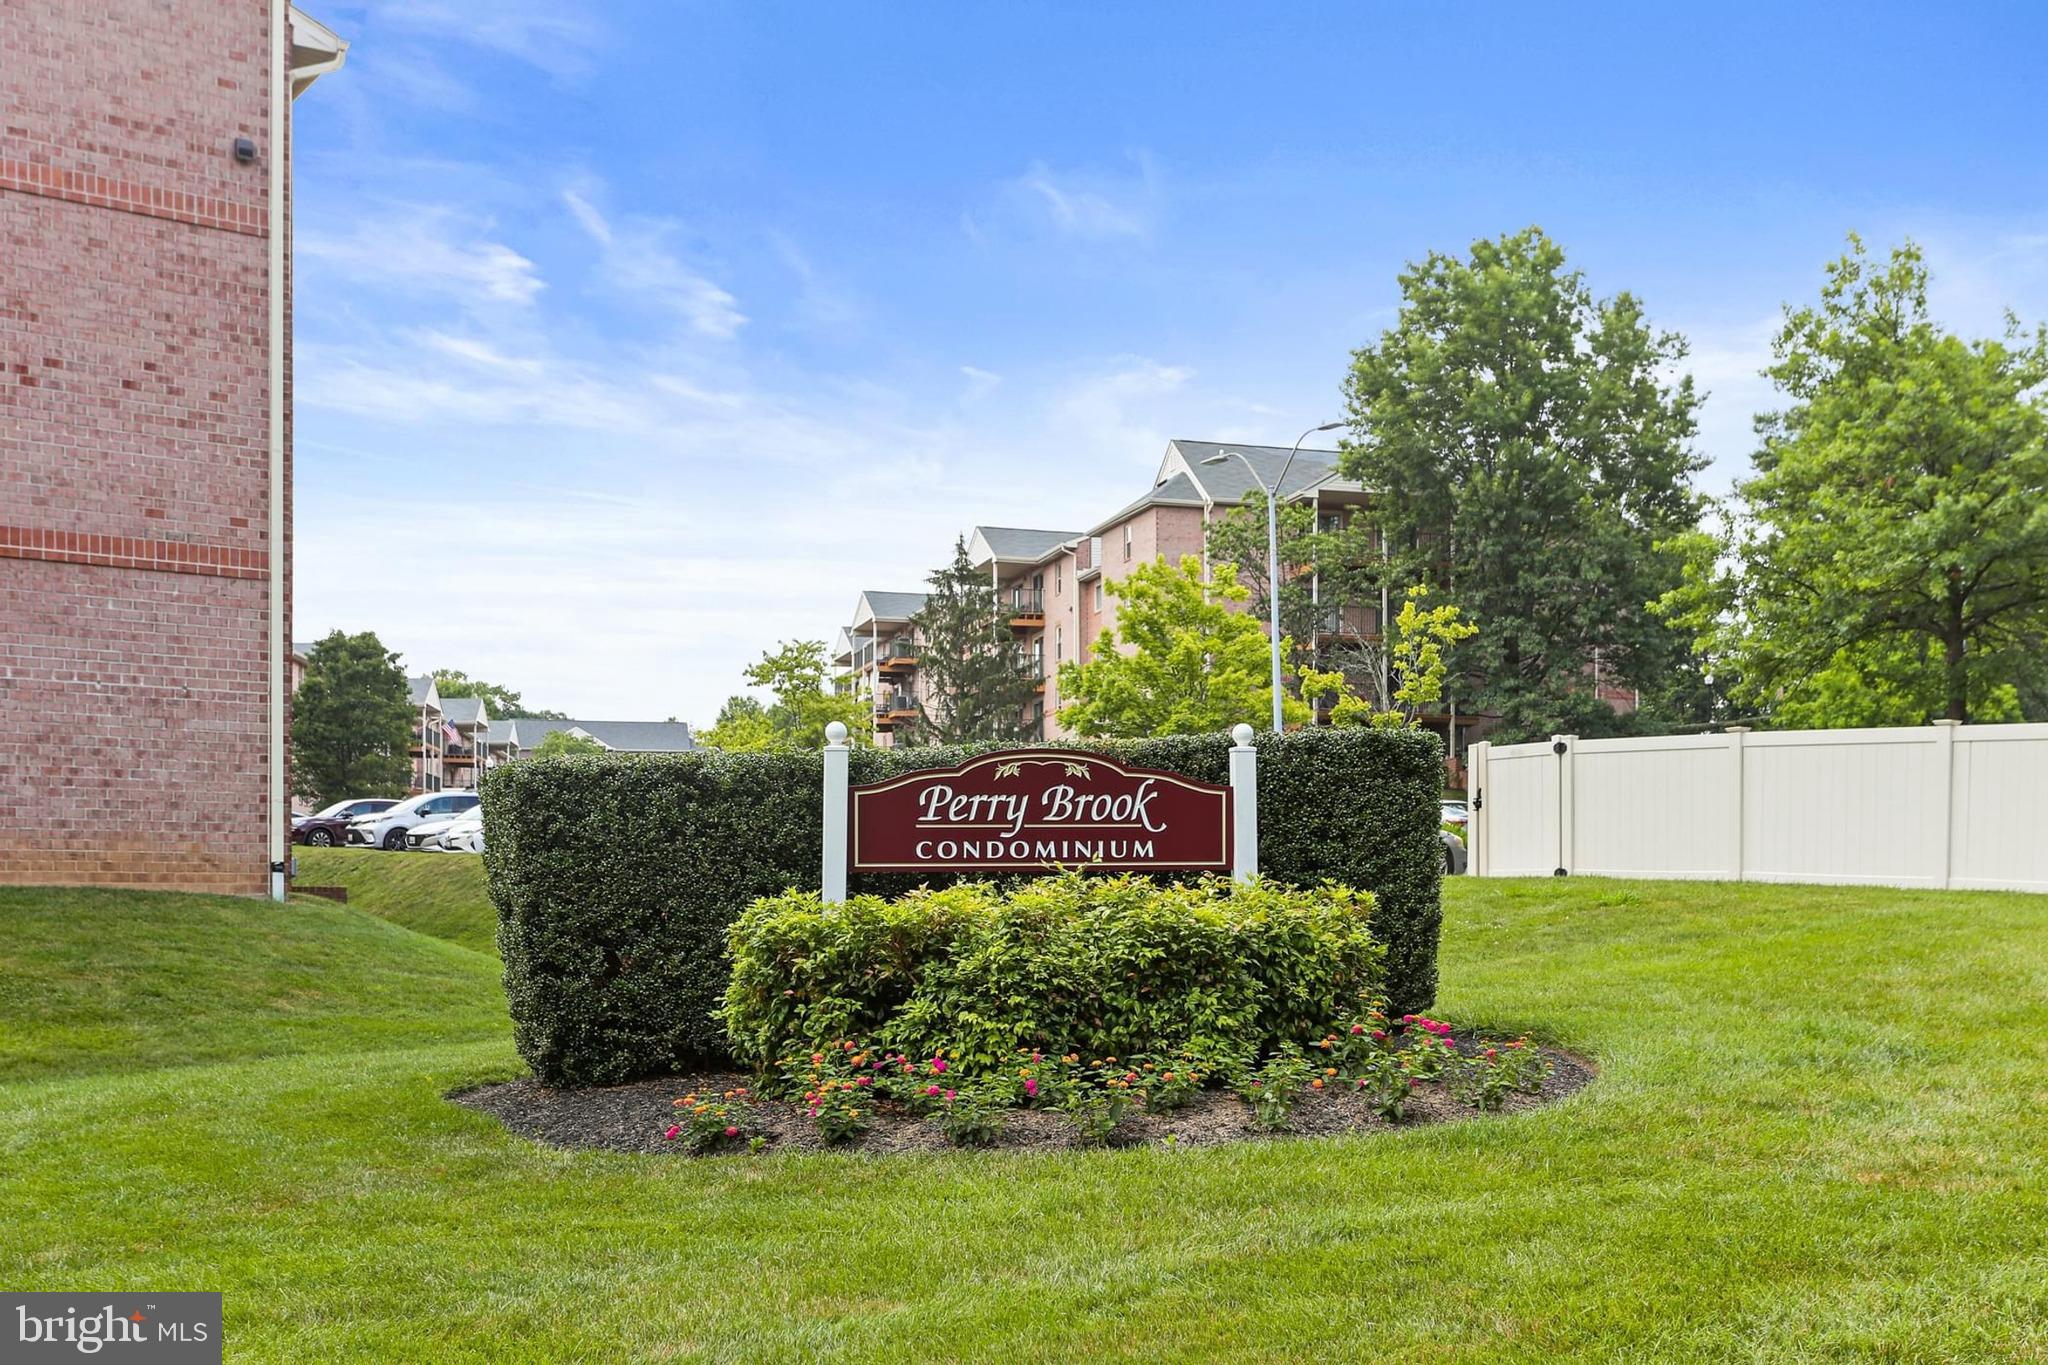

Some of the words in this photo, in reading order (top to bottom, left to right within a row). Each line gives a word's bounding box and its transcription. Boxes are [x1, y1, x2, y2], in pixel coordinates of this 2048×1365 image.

[918, 784, 1029, 838] Perry
[1041, 778, 1167, 833] Brook
[916, 840, 1154, 860] CONDOMINIUM
